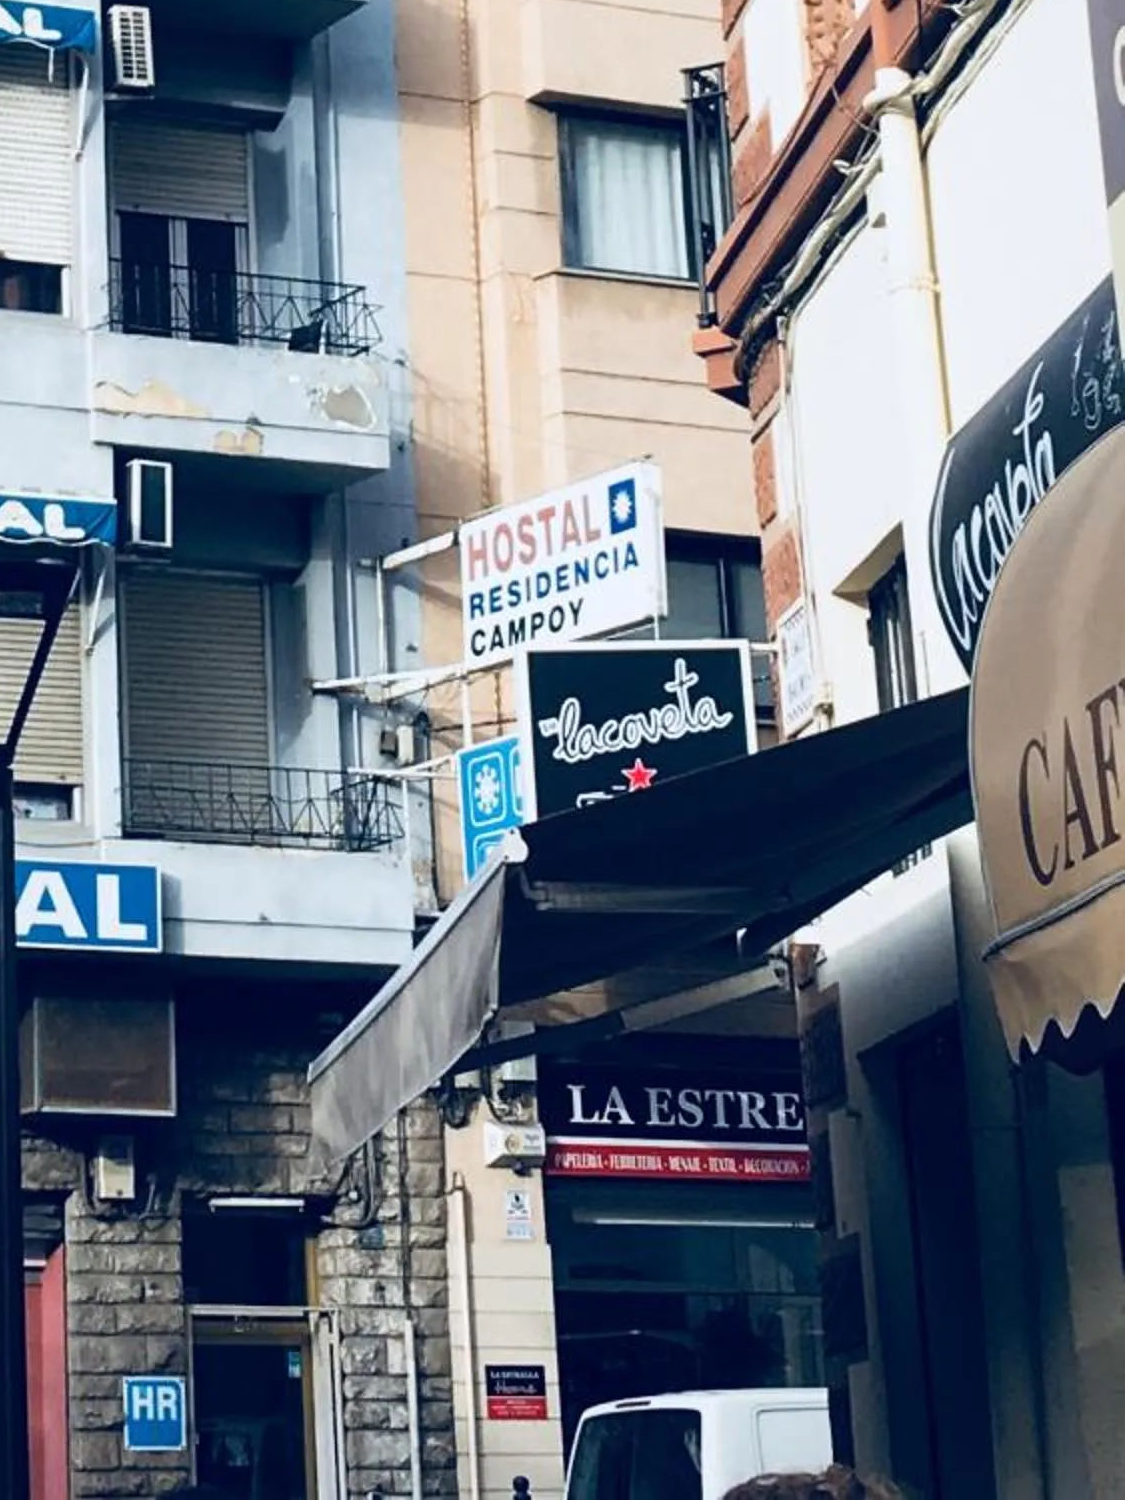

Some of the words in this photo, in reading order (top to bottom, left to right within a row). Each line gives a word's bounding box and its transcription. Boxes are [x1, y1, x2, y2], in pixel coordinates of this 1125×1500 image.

[467, 494, 602, 581] HOSTAL
[469, 541, 639, 620] RESIDENCIA
[470, 598, 584, 656] CAMPOY
[1018, 677, 1125, 886] CAF
[566, 1084, 636, 1125] LA
[644, 1087, 805, 1131] ESTRE
[131, 1385, 177, 1421] HR
